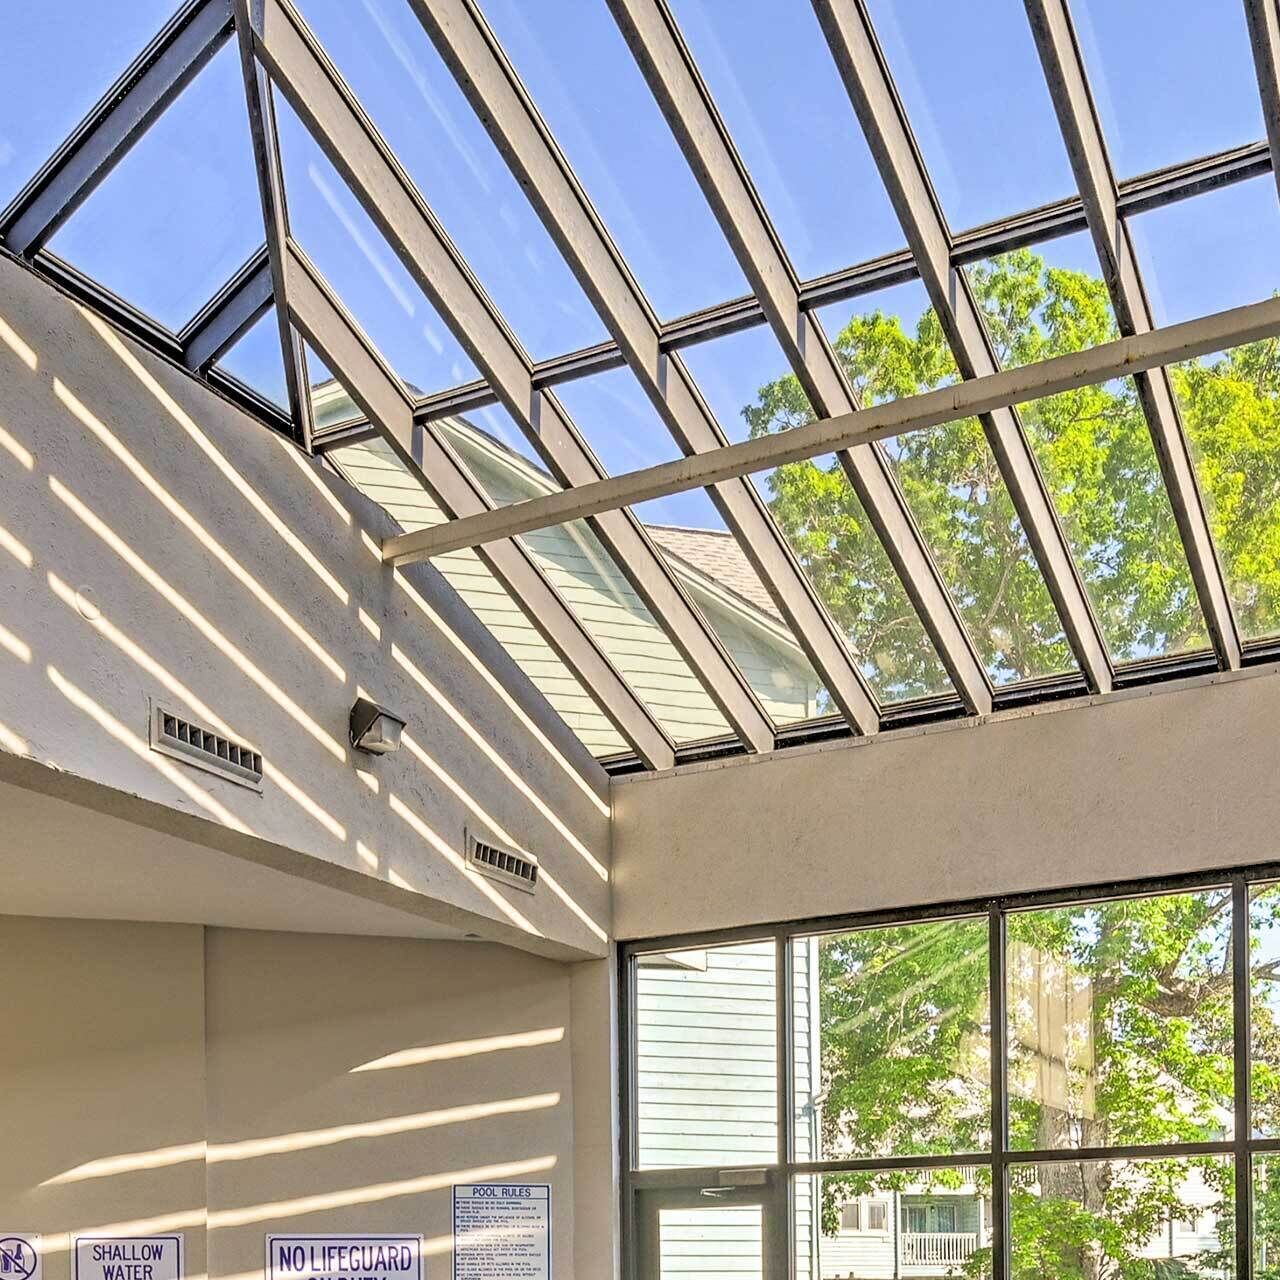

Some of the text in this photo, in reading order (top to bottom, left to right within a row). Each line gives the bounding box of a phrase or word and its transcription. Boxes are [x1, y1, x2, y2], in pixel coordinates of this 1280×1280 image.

[472, 1187, 531, 1197] POOL RULES
[93, 1244, 163, 1261] SHALLOW
[279, 1245, 412, 1271] NO LIFEGUARD
[103, 1264, 153, 1280] WATER
